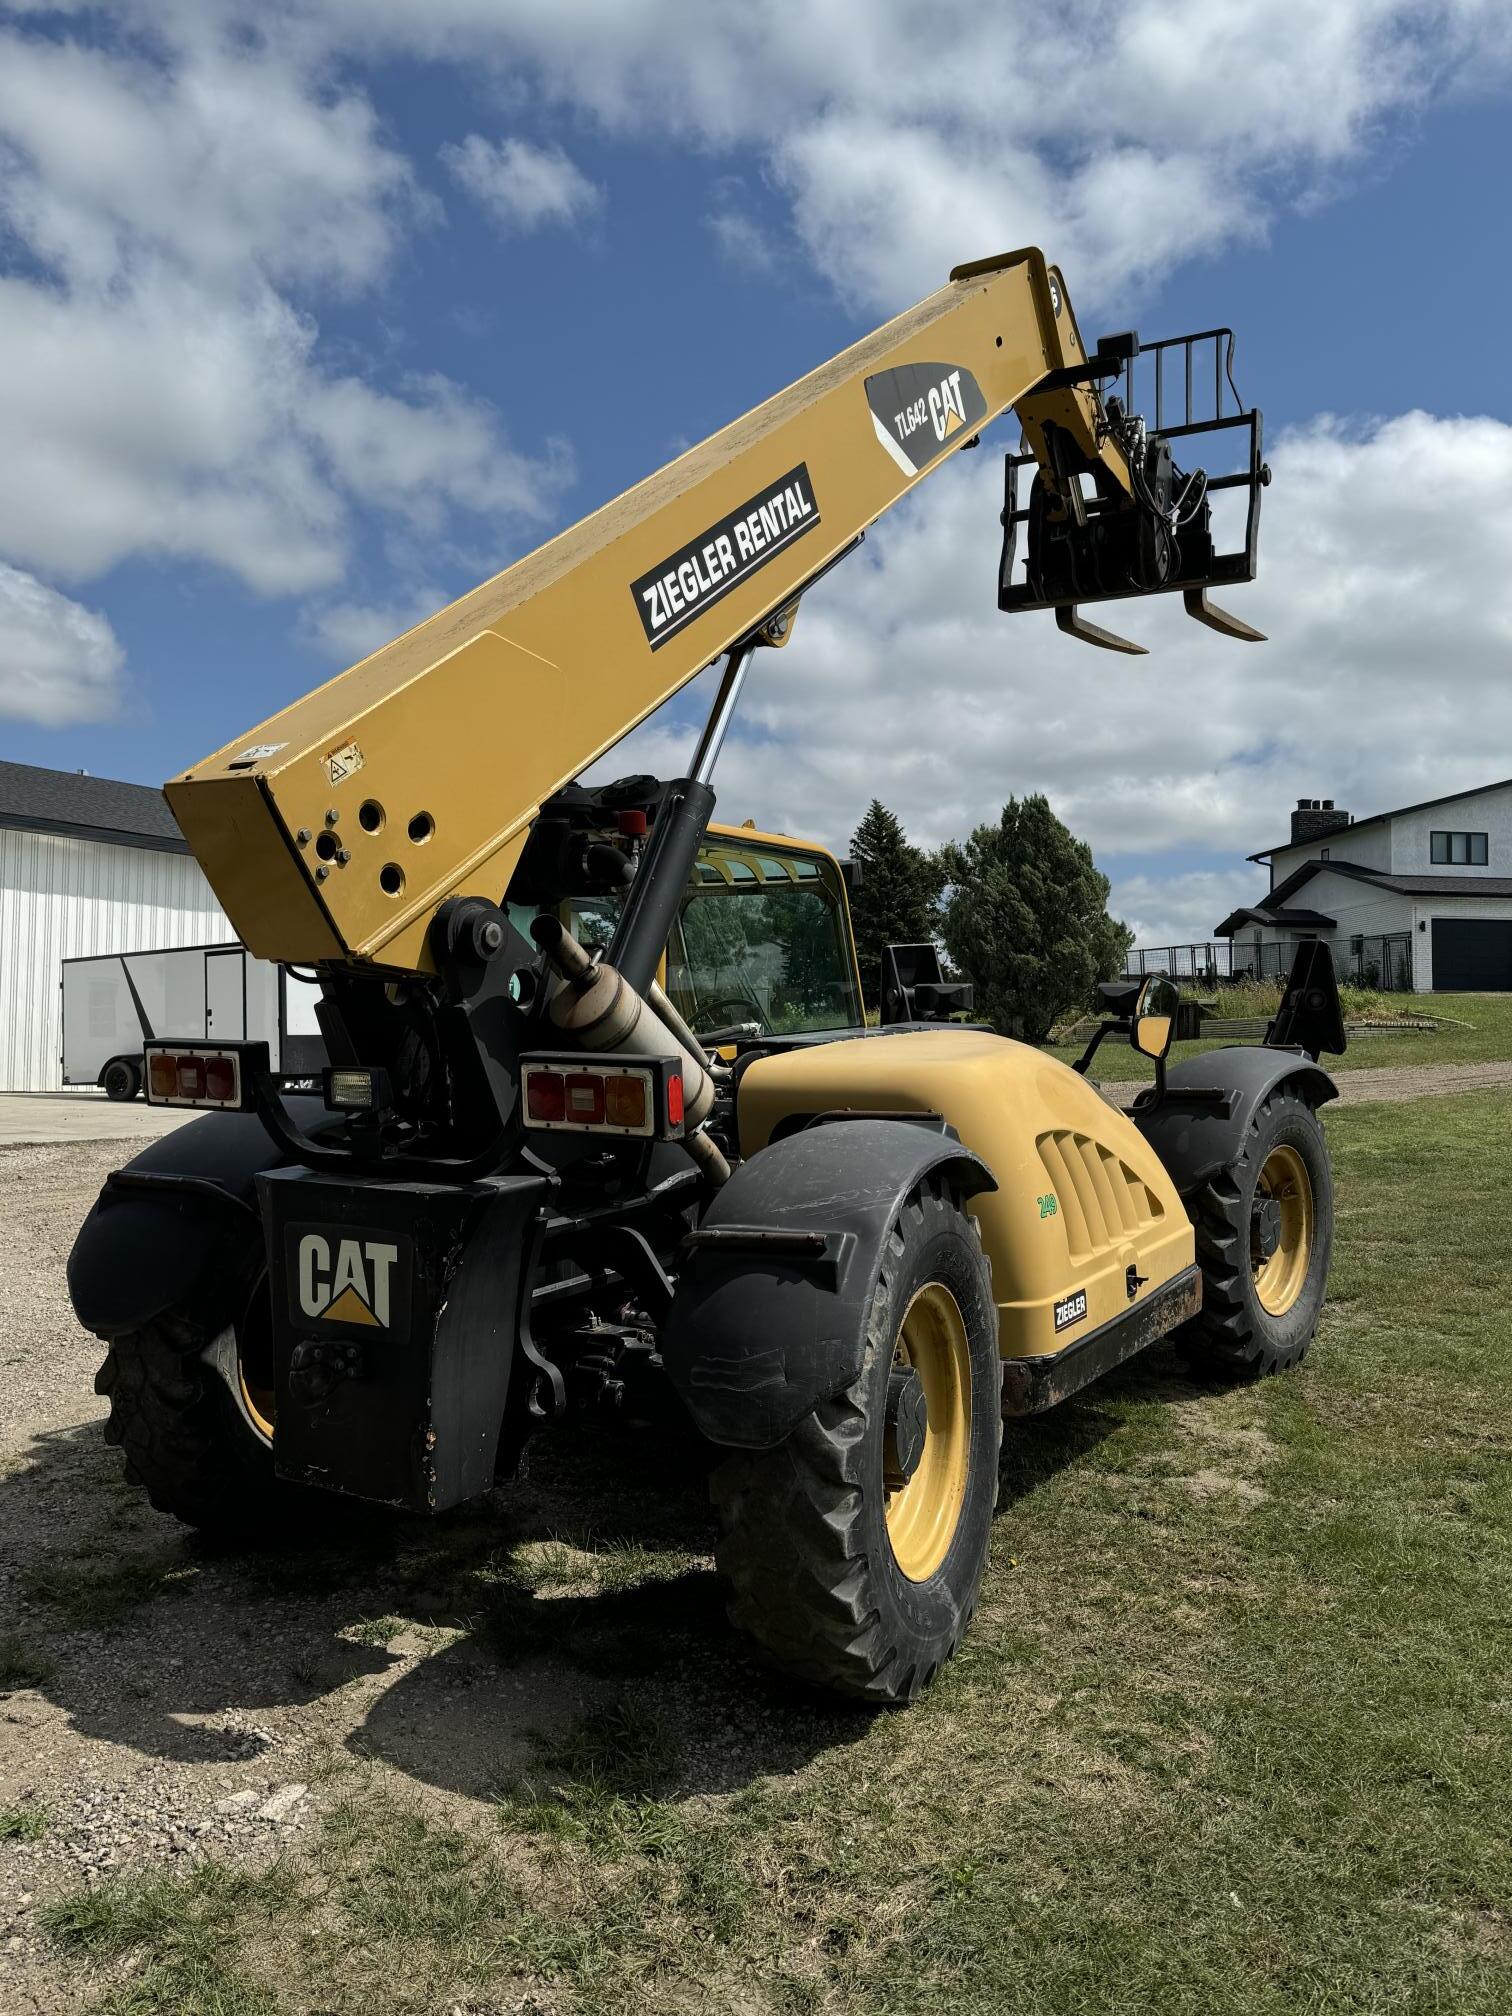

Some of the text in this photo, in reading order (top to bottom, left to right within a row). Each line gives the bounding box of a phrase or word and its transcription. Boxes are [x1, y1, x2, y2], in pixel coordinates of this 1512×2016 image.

[894, 370, 967, 442] TL642 CAT
[642, 481, 812, 630] ZIEGLER RENTAL
[299, 1234, 398, 1329] CAT
[1056, 1295, 1086, 1326] ZIEGLER
